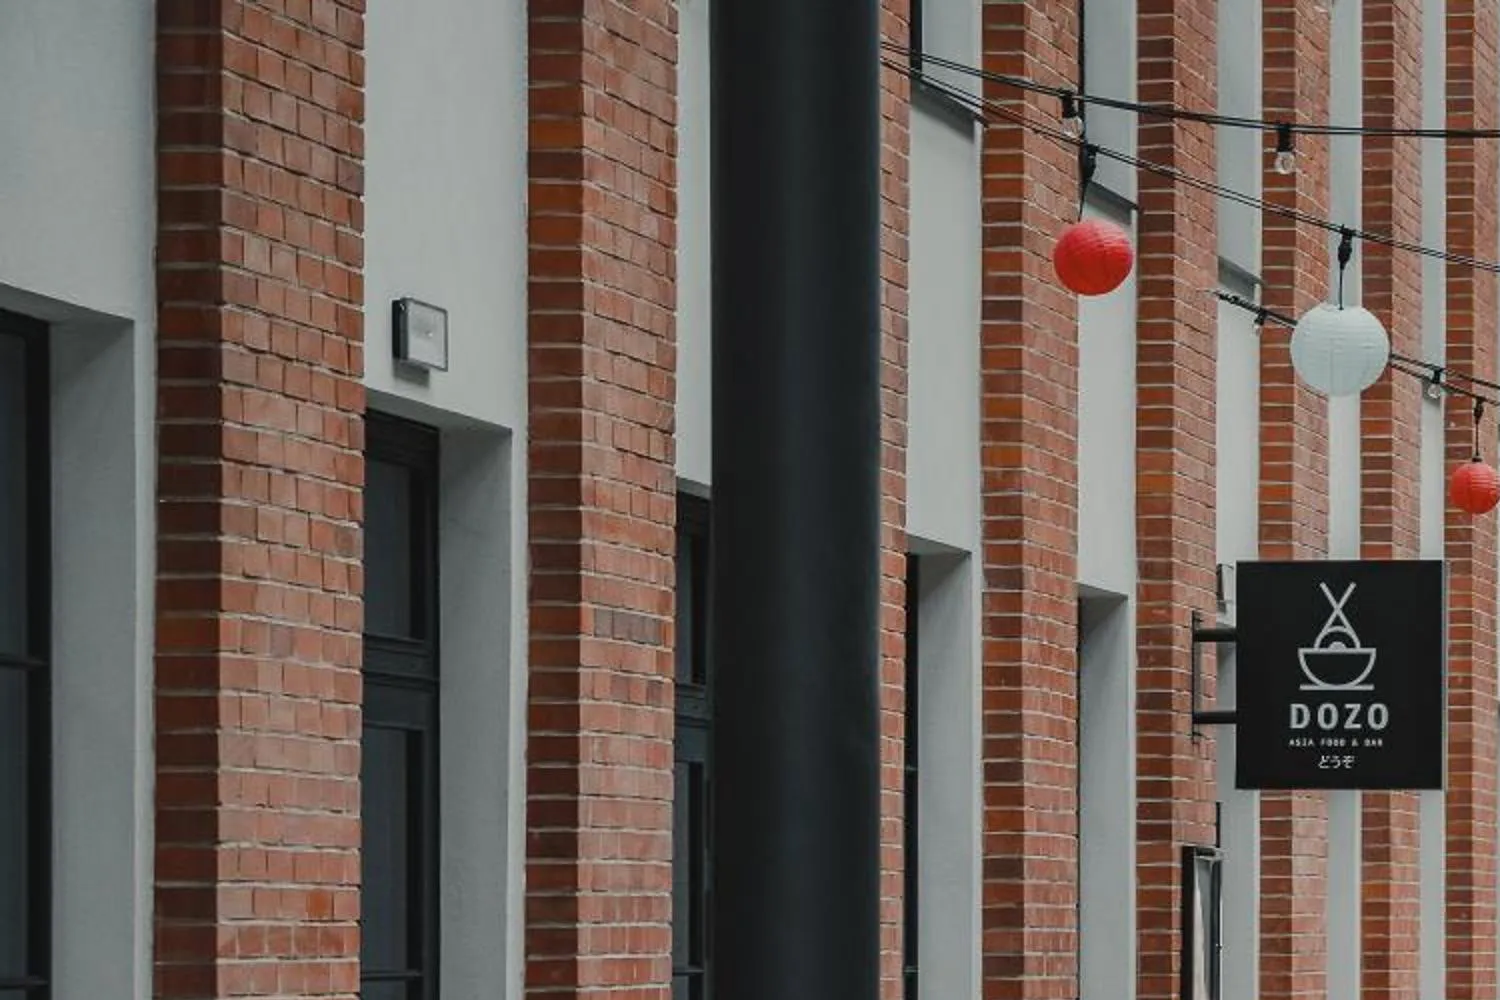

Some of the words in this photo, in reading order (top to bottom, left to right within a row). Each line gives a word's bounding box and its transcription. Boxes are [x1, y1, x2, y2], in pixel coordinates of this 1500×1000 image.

[1289, 703, 1389, 730] DOZO
[1289, 738, 1315, 747] ASIA
[1320, 738, 1346, 747] FOOD
[1351, 738, 1359, 747] &
[1364, 738, 1383, 747] BAR
[1318, 755, 1355, 769] どうぞ
